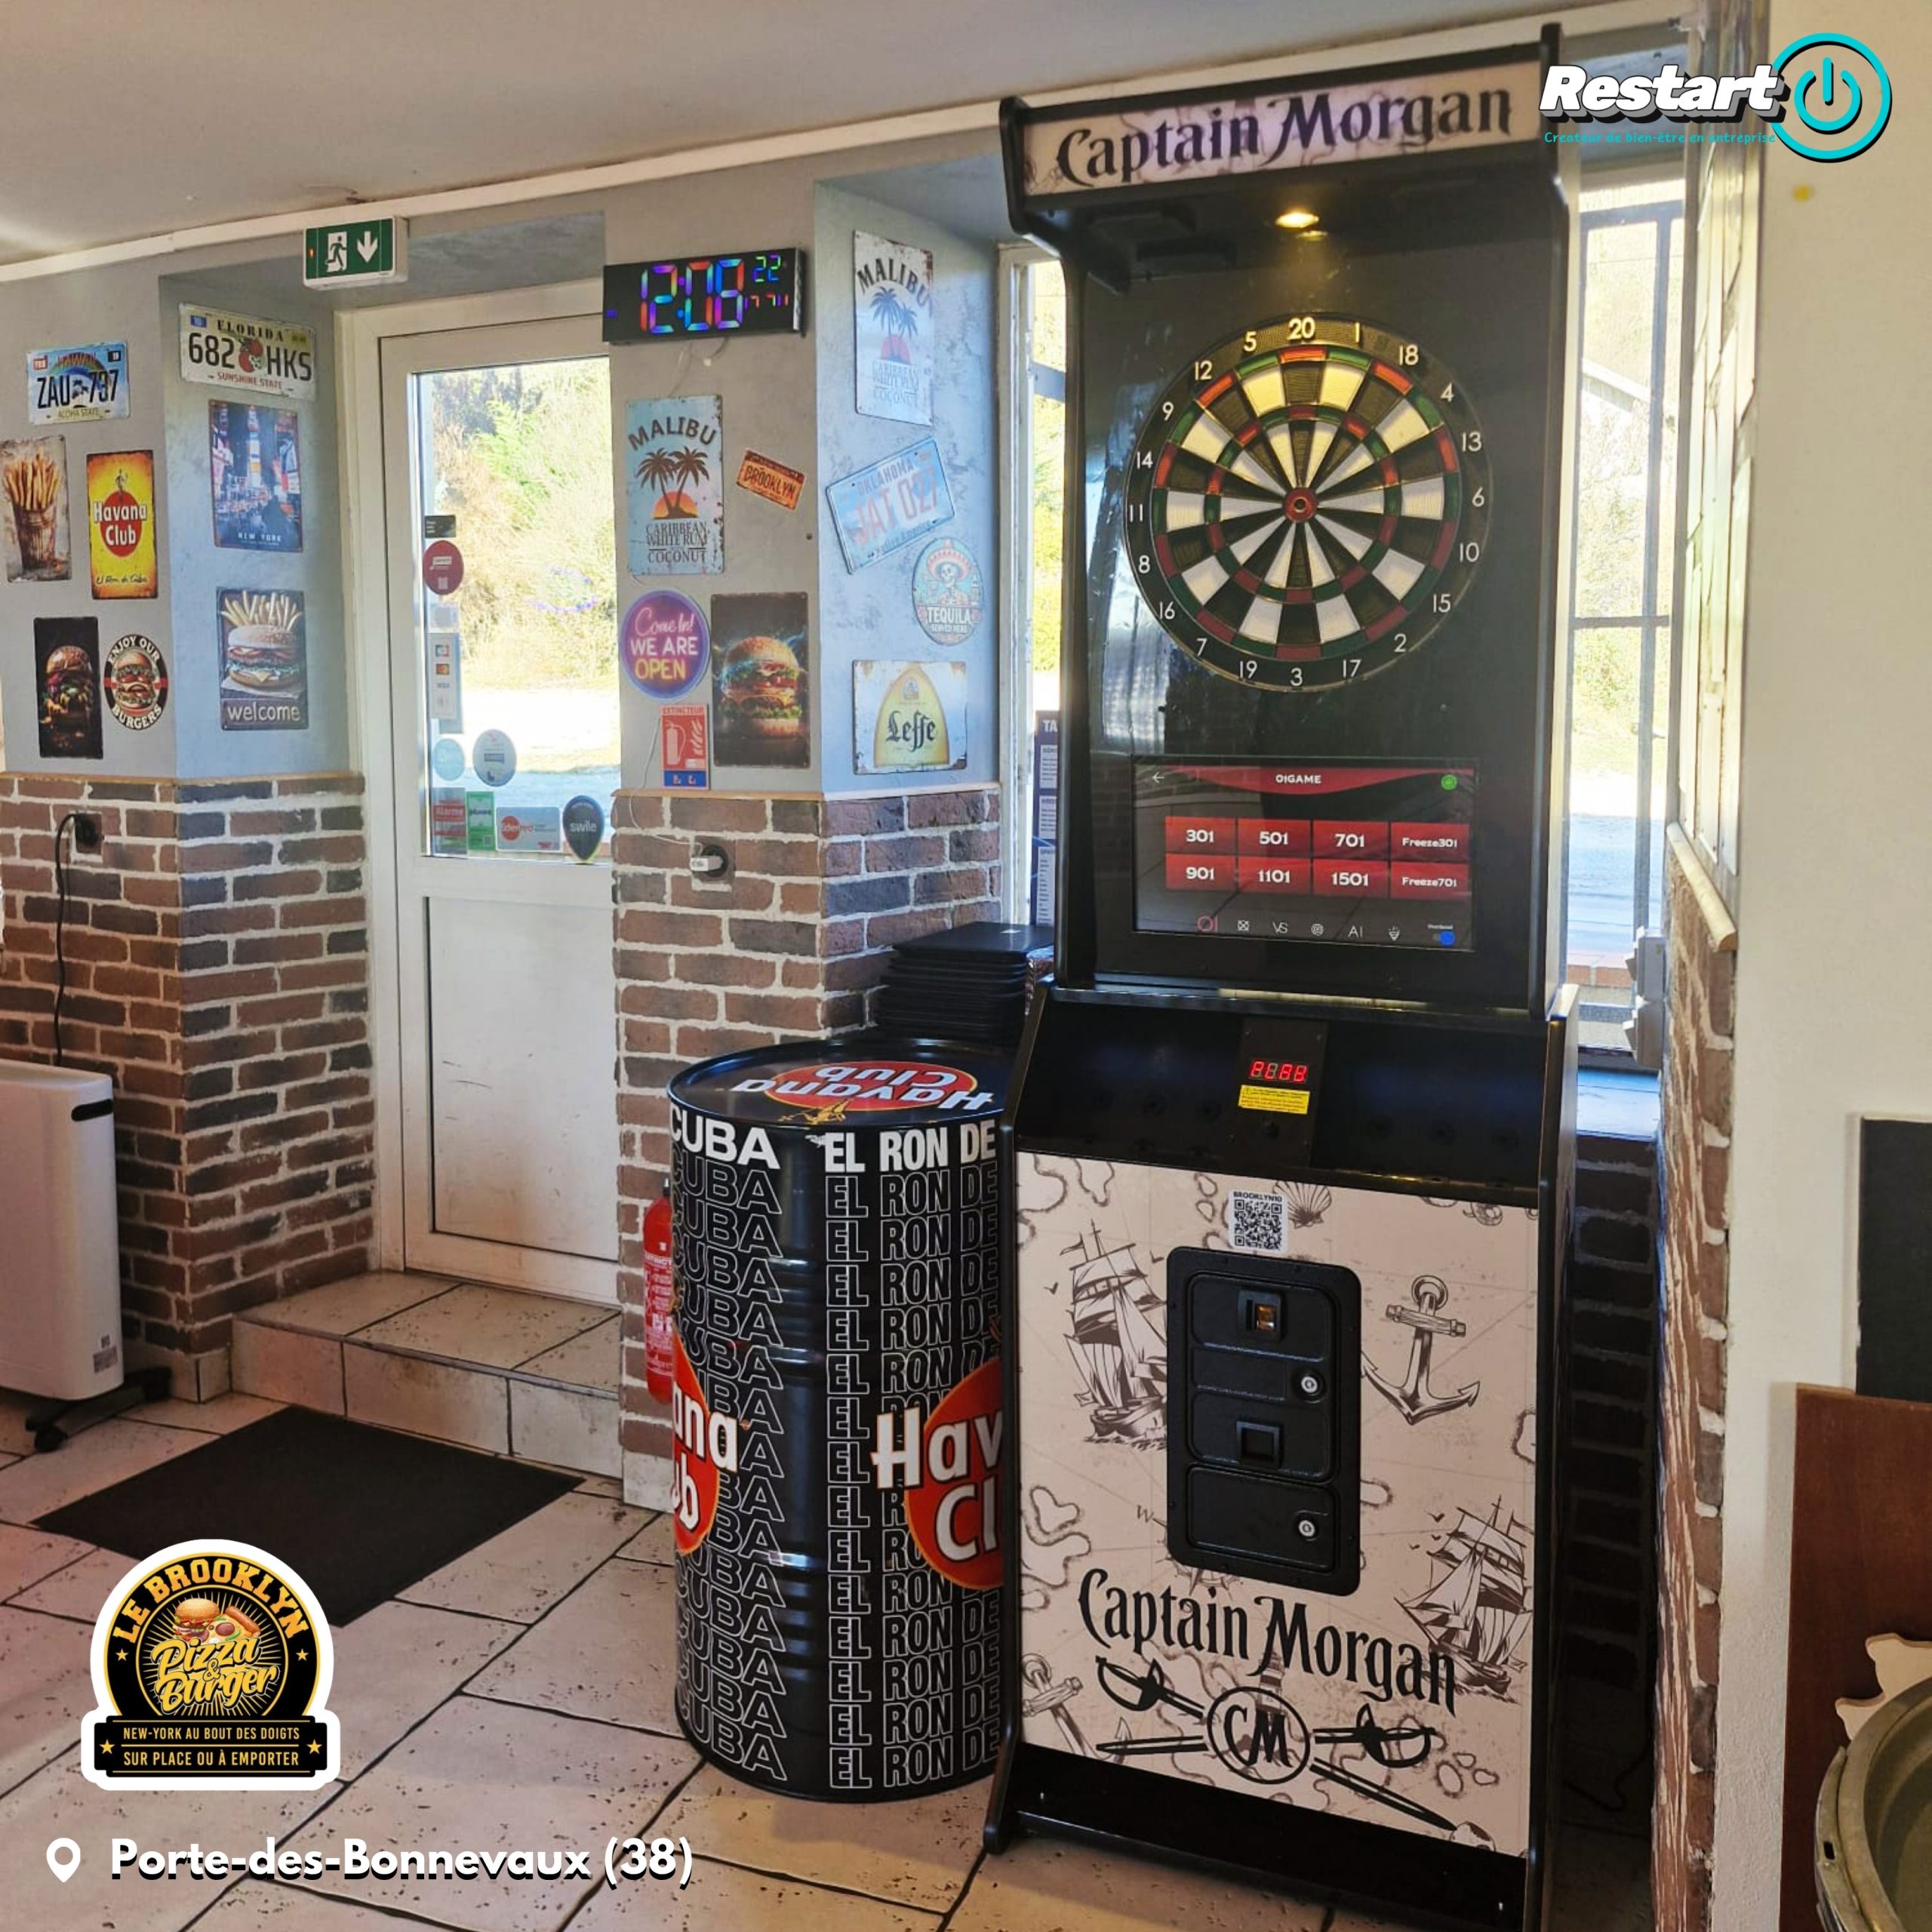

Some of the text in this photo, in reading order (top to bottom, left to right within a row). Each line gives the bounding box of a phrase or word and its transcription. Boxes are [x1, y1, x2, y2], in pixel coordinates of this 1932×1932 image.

[1057, 87, 1512, 189] Captain Morgan
[857, 258, 931, 307] MALIBU
[639, 258, 744, 334] 12:08
[1288, 317, 1316, 339] 20
[1355, 322, 1361, 342] 1
[1244, 332, 1257, 351] 5
[189, 332, 312, 381] 682 HKS
[1399, 346, 1420, 365] 18
[1195, 361, 1213, 380] 12
[37, 374, 70, 409] ZAU
[259, 378, 283, 389] STATE
[1440, 383, 1454, 401] 4
[1162, 402, 1174, 420] 9
[628, 417, 716, 451] MALIBU
[1462, 432, 1481, 451] 13
[1137, 451, 1153, 469] 14
[743, 465, 797, 500] BROOKLYN
[856, 457, 915, 496] OKLAHOMA
[1472, 488, 1484, 507] 6
[94, 501, 148, 523] Havana
[1129, 505, 1143, 522] 11
[106, 525, 137, 546] Club
[646, 521, 708, 537] CARIBBEAN
[647, 533, 708, 547] WHITE RUM
[648, 549, 707, 564] COCONUT
[1460, 543, 1480, 561] 10
[1139, 556, 1151, 574] 8
[1160, 602, 1175, 620] 16
[1433, 595, 1451, 613] 15
[635, 607, 677, 637] Come
[927, 607, 971, 625] TEQUILA
[108, 635, 161, 663] ENJOY OUR
[630, 636, 699, 657] WE ARE
[1197, 639, 1208, 656] 7
[1395, 635, 1407, 652] 2
[635, 658, 686, 680] OPEN
[1239, 661, 1257, 679] 19
[1291, 669, 1303, 687] 3
[1343, 660, 1361, 678] 17
[112, 704, 162, 729] BURGERS
[226, 700, 300, 723] welcome
[885, 710, 937, 752] Leffe
[1186, 829, 1214, 843] 301
[1259, 832, 1288, 846] 501
[1335, 834, 1365, 848] 701
[1402, 837, 1457, 848] Freeze301
[1186, 867, 1214, 881] 901
[1257, 870, 1291, 884] 1101
[1331, 872, 1368, 887] 1501
[1401, 876, 1457, 888] Freeze701
[1272, 921, 1289, 934] VS
[1348, 925, 1363, 937] AI
[731, 1064, 994, 1111] Havana Club
[670, 1105, 780, 1170] CUBA
[825, 1119, 996, 1173] EL RON DE
[826, 1160, 998, 1218] EL RON DE
[1233, 1191, 1282, 1202] BROOKLYN10
[826, 1203, 998, 1262] EL RON DE
[827, 1246, 998, 1307] EL RON DE
[827, 1354, 869, 1394] EL
[870, 1411, 1002, 1489] Hav
[829, 1575, 871, 1614] EL
[829, 1606, 953, 1659] EL RON
[1078, 1567, 1457, 1718] Captain Morgan
[829, 1650, 953, 1702] EL RON
[830, 1748, 872, 1789] EL
[883, 1736, 954, 1788] RON
